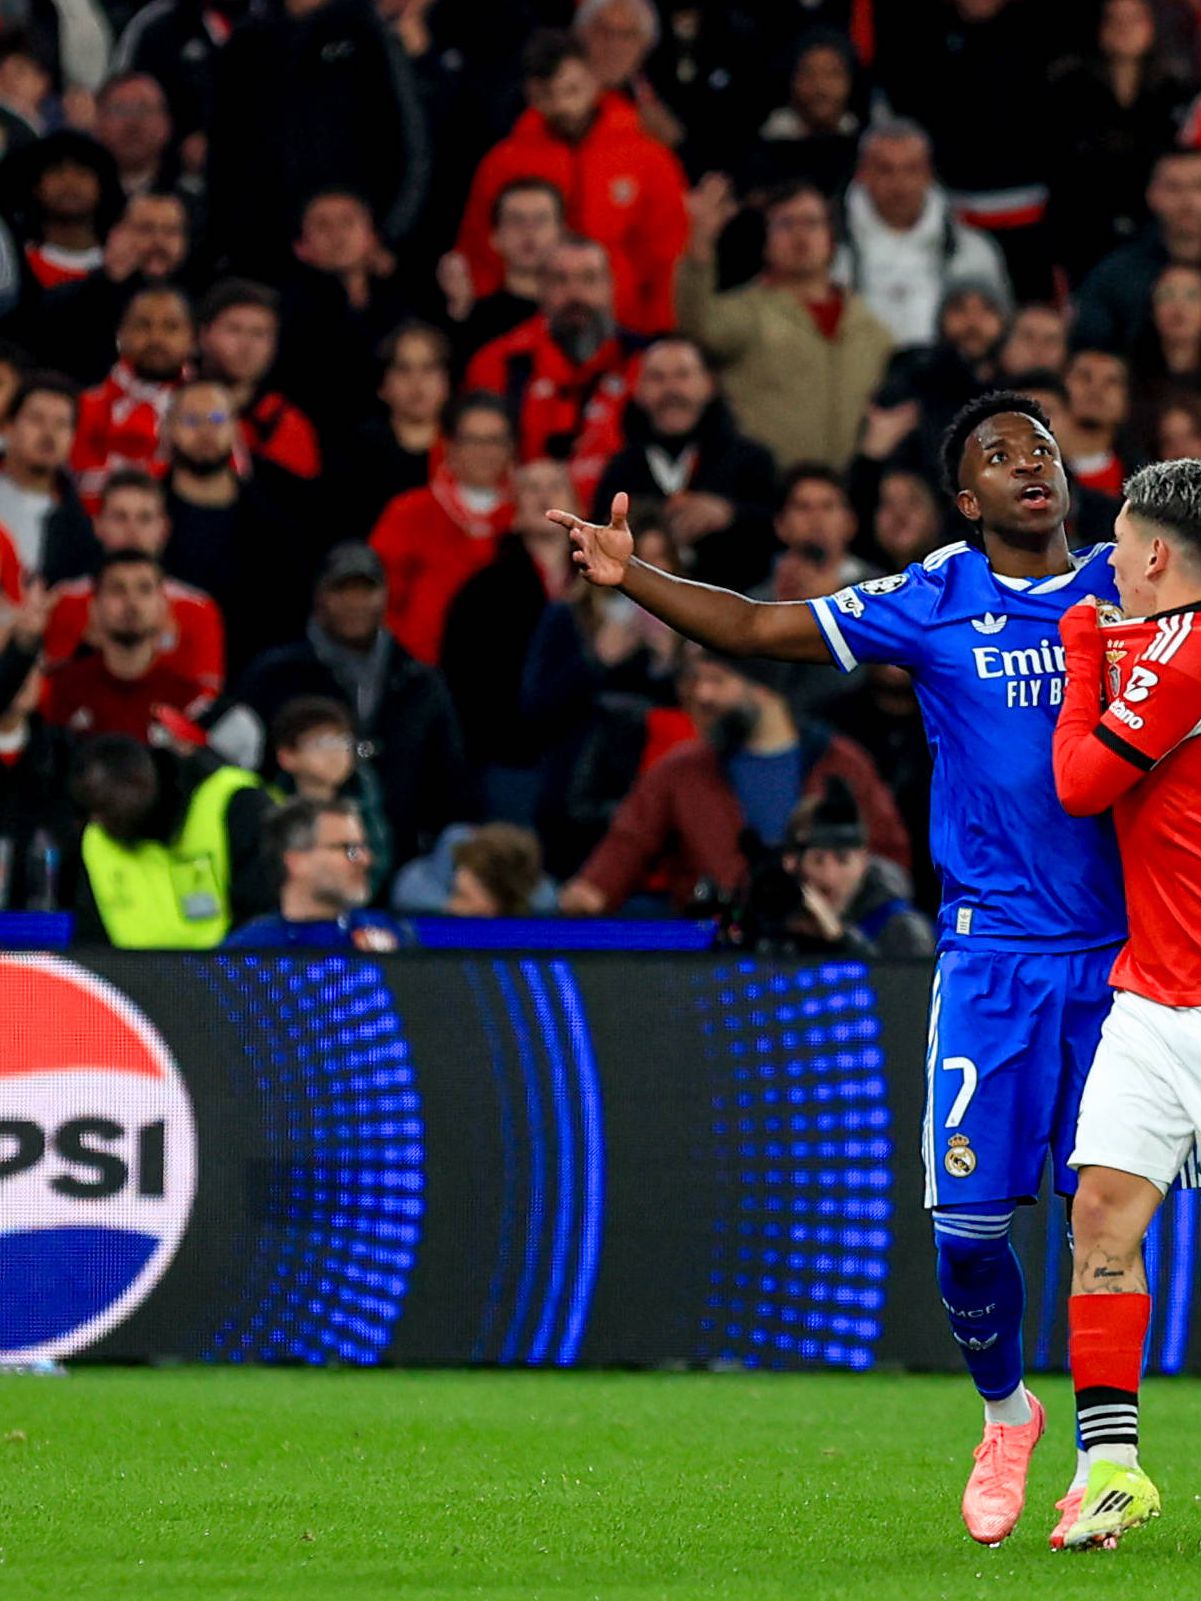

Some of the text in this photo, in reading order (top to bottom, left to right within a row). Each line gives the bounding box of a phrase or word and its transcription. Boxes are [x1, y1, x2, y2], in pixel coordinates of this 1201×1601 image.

[1007, 676, 1069, 708] FLY B
[942, 1056, 978, 1129] 7
